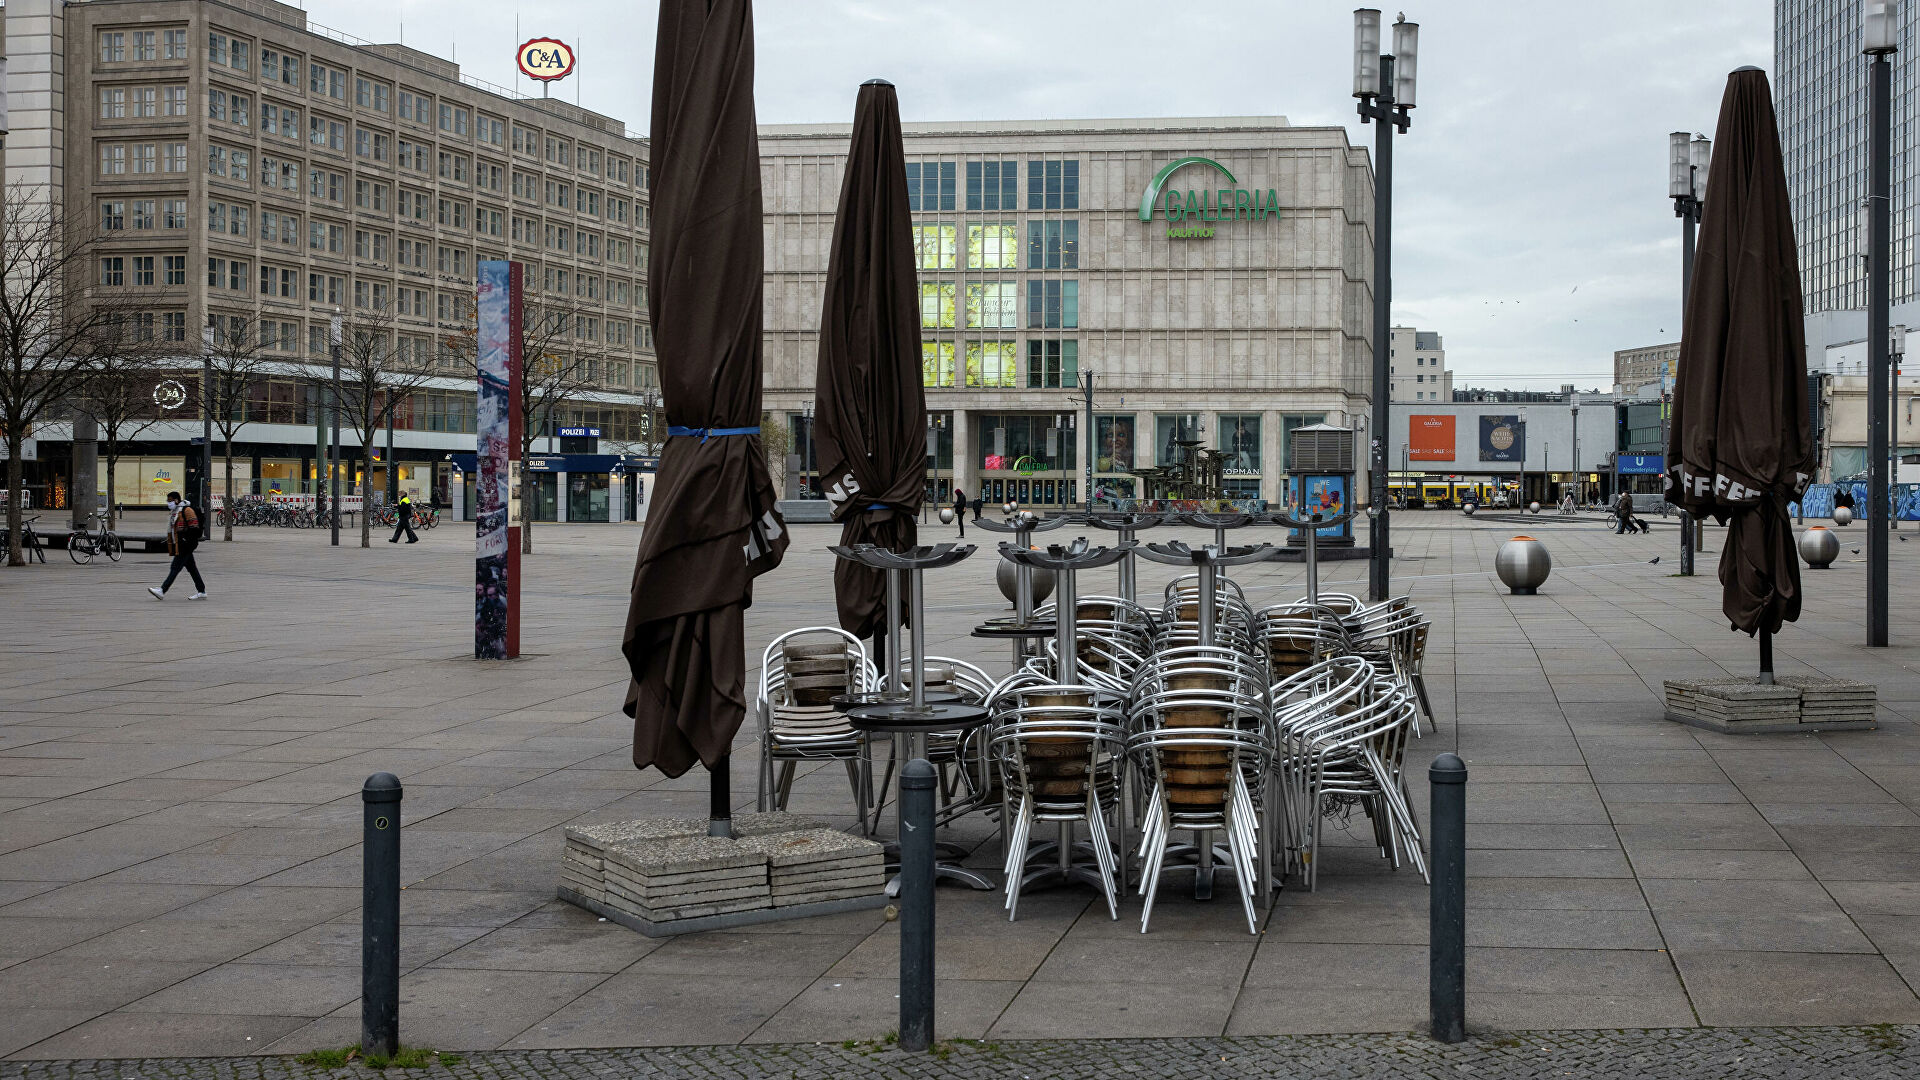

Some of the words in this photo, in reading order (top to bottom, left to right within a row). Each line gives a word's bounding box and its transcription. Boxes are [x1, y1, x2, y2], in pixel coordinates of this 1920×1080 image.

[526, 48, 565, 69] C&A
[1165, 189, 1281, 222] GALERIA
[561, 428, 585, 436] POLIZEI
[1019, 462, 1048, 471] GALERIA
[1635, 456, 1644, 467] U
[156, 468, 170, 479] dm
